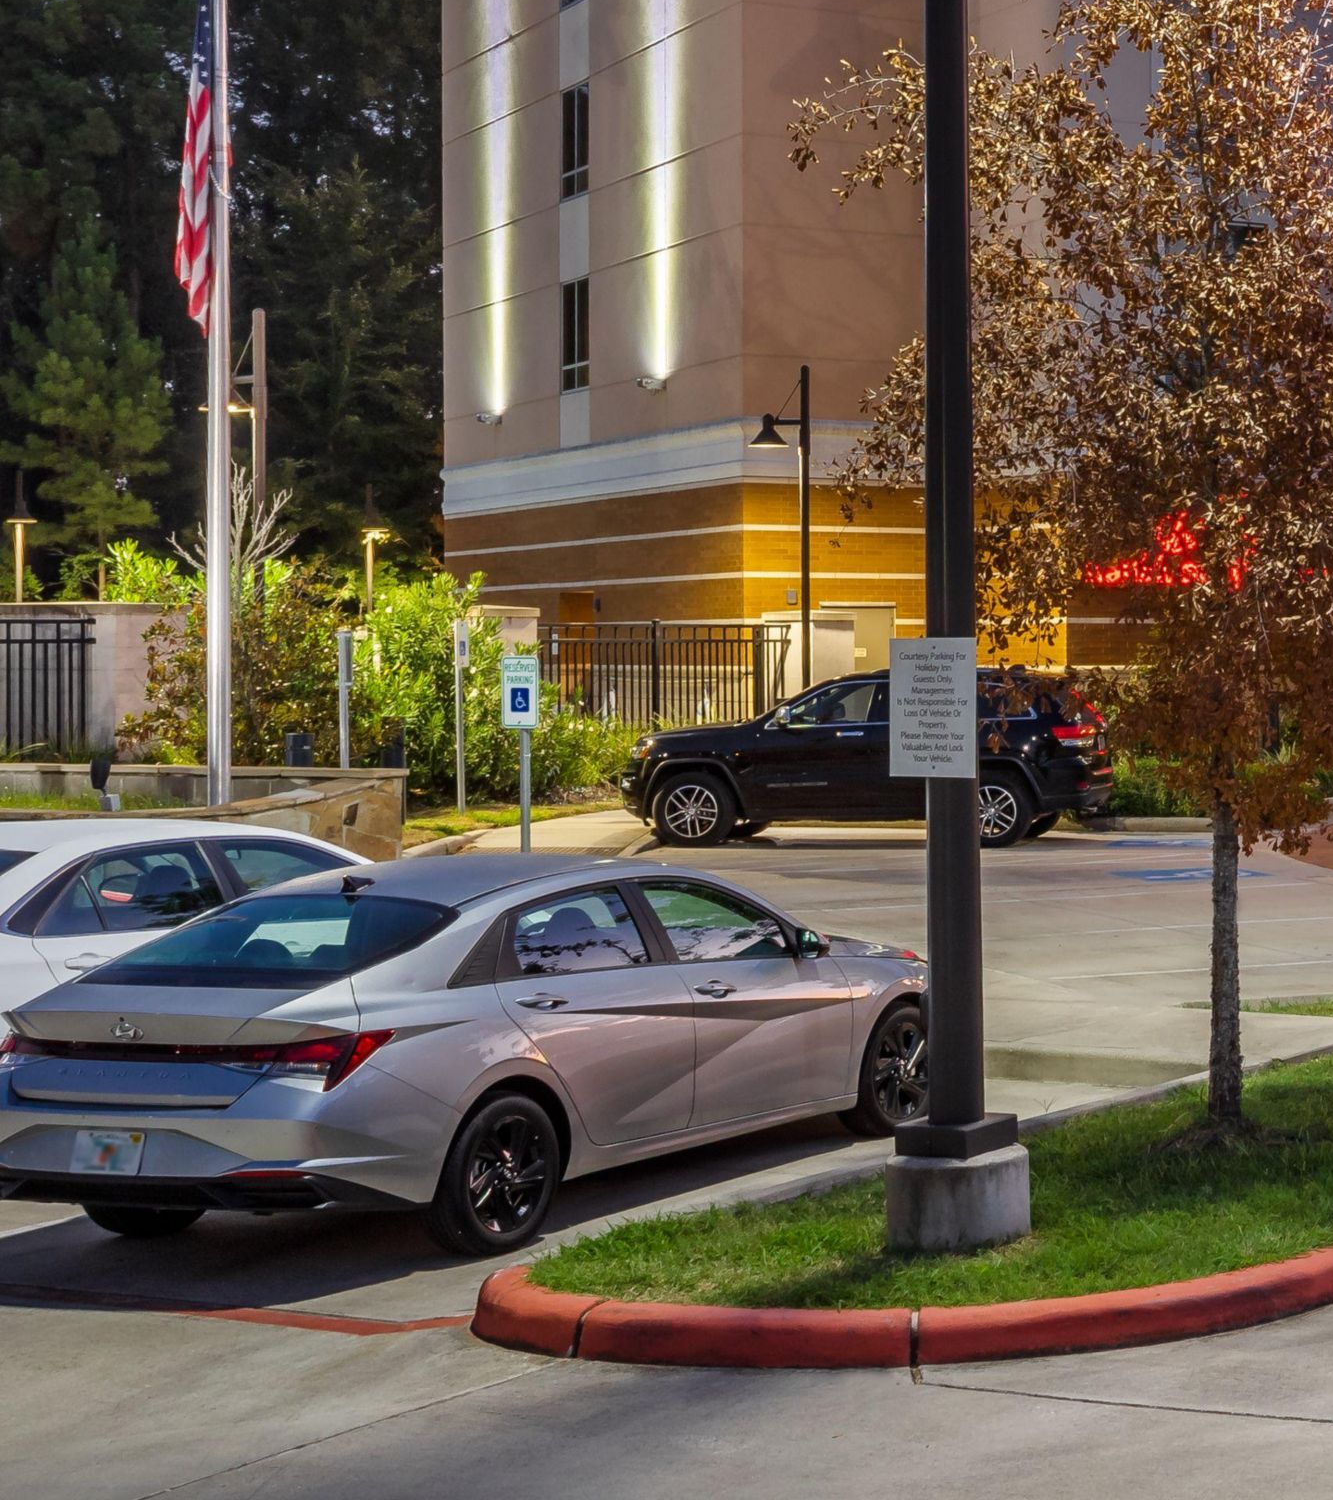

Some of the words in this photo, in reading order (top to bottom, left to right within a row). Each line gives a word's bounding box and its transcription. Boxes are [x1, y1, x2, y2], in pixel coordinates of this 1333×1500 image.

[899, 652, 929, 662] Courtesy
[930, 652, 955, 663] Parking
[956, 652, 967, 660] For
[505, 664, 535, 672] RESERVED
[915, 663, 940, 674] Holiday
[942, 664, 952, 672] Inn
[506, 675, 533, 684] PARKING
[912, 675, 936, 683] Guests
[911, 686, 955, 696] Management
[897, 698, 902, 706] Is
[904, 698, 916, 706] Not
[917, 697, 956, 707] Responsible
[957, 698, 968, 706] For
[904, 709, 918, 717] Loss
[919, 709, 928, 717] Of
[929, 709, 952, 717] Vehicle
[953, 709, 962, 717] Or
[901, 731, 921, 740] Please
[923, 731, 949, 740] Remove
[951, 732, 965, 740] Your
[901, 742, 932, 751] Valuables
[934, 743, 948, 751] And
[949, 743, 964, 751] Lock
[913, 754, 928, 762] Your
